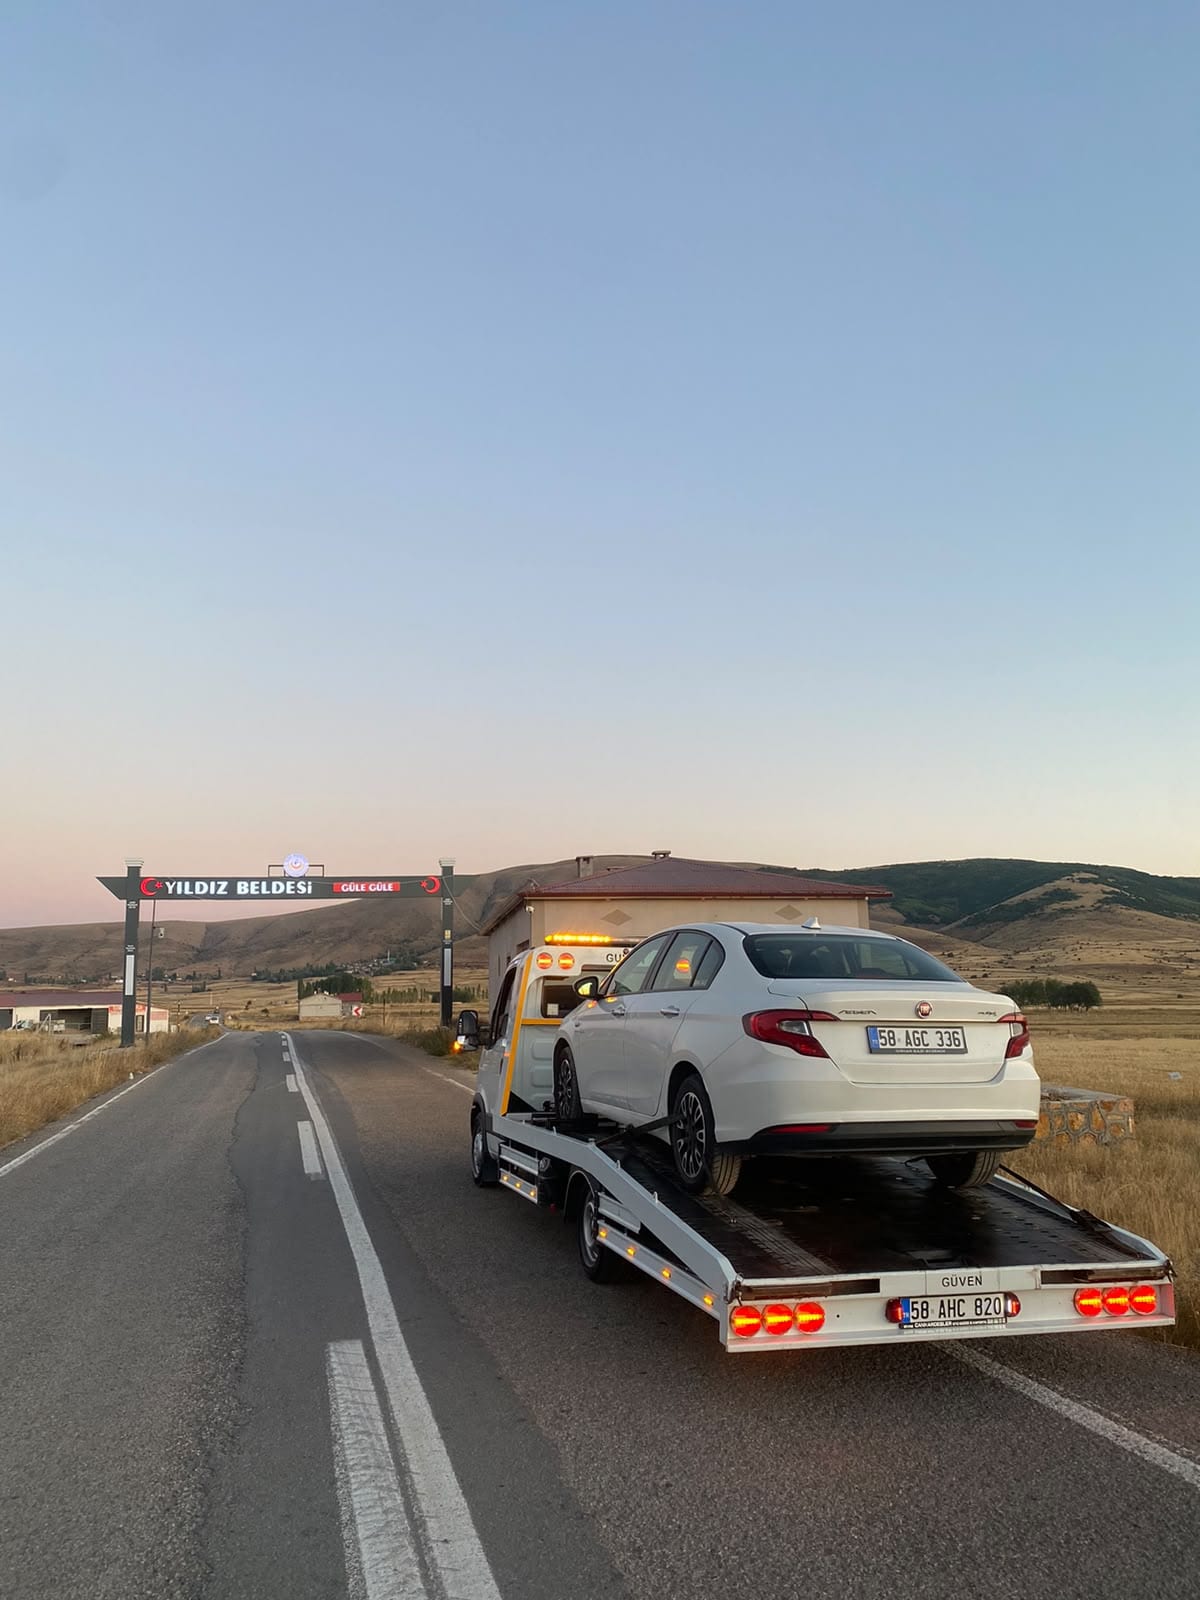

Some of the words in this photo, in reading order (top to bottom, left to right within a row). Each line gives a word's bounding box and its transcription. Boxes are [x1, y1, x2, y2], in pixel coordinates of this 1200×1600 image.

[164, 880, 228, 895] YILDIZ
[341, 881, 366, 892] GÜLE
[368, 881, 394, 892] GÜLE
[878, 1029, 896, 1047] 58
[905, 1029, 930, 1047] AGC
[935, 1030, 961, 1048] 336
[941, 1274, 983, 1288] GÜVEN
[911, 1300, 929, 1320] 58
[938, 1298, 966, 1319] AHC
[974, 1297, 1002, 1316] 820
